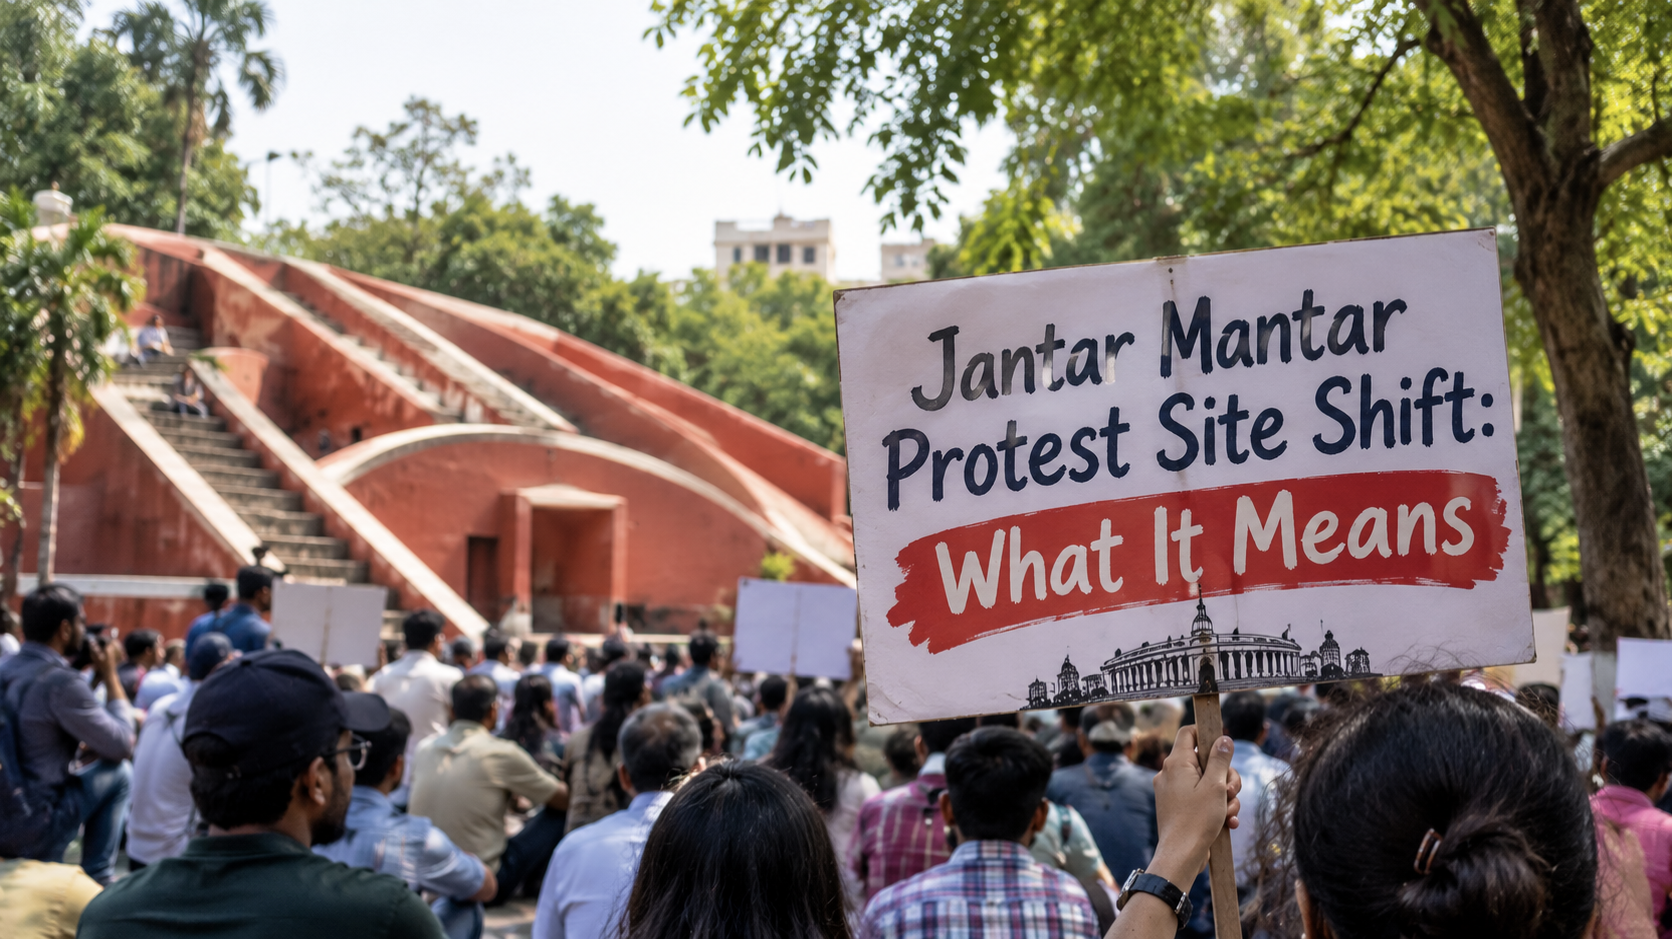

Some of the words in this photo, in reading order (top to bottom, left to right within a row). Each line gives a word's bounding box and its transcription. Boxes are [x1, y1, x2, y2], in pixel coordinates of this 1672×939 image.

[911, 323, 1135, 411] Jantar
[1159, 289, 1407, 378] Mantar
[882, 406, 1130, 511] Protest
[1156, 392, 1288, 471] Site
[1313, 367, 1495, 455] Shift:
[935, 518, 1125, 614] What
[1154, 505, 1204, 585] It
[1233, 489, 1475, 574] Means
